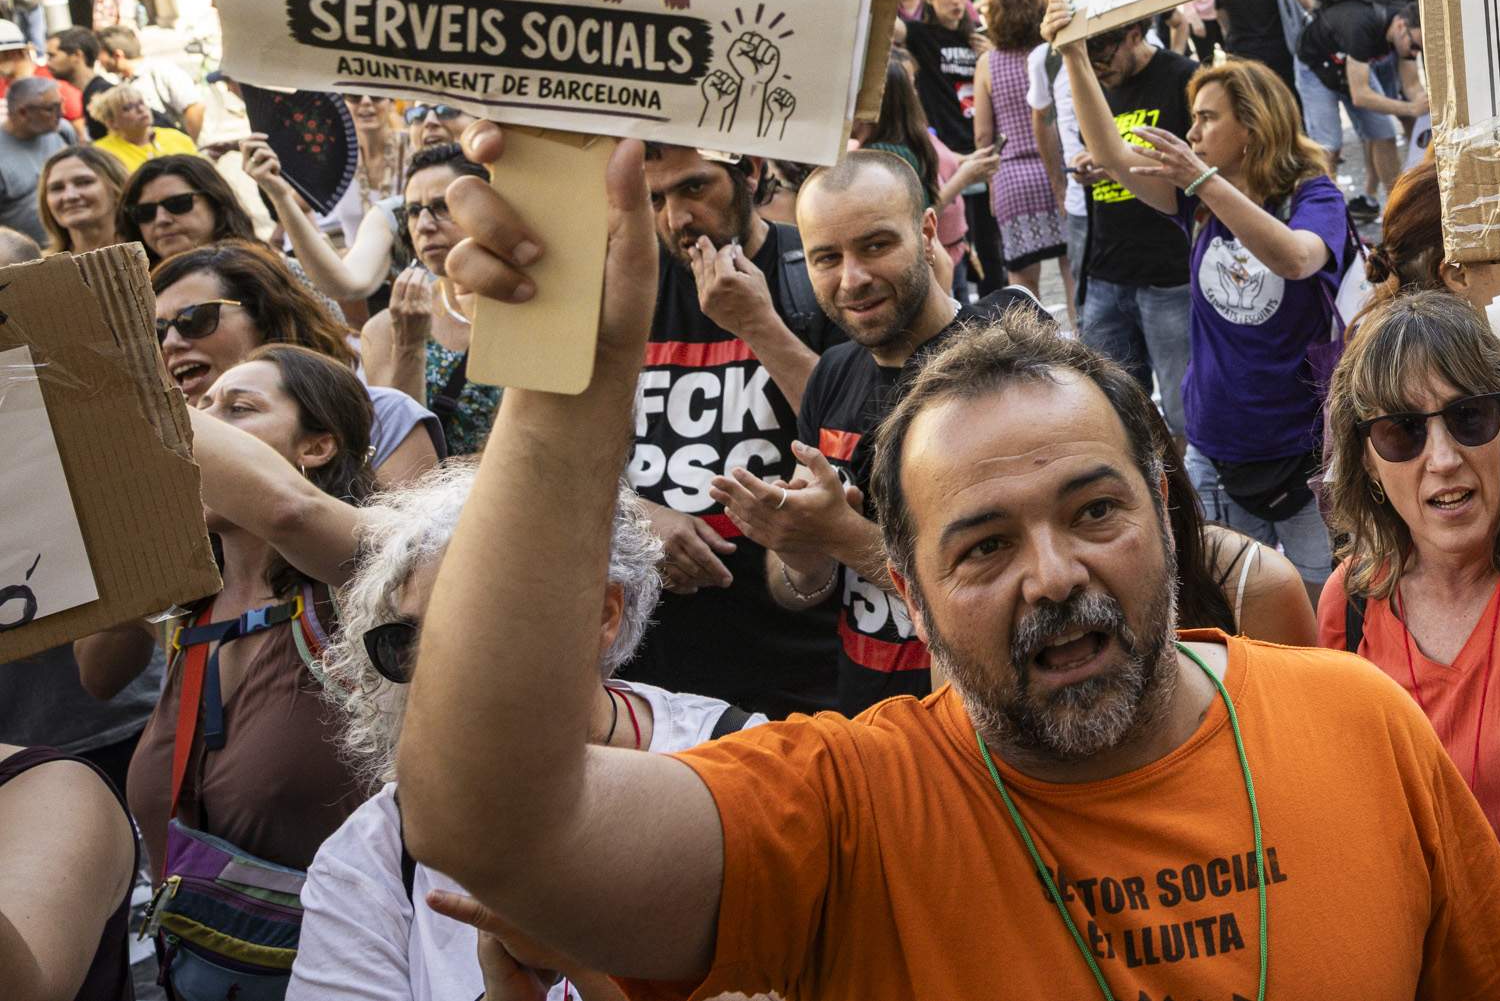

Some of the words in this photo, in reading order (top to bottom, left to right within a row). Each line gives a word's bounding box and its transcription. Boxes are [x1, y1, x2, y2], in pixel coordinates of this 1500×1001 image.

[521, 10, 695, 74] SOCIALS
[336, 54, 495, 95] AJUNTAMENT
[502, 76, 530, 97] DE
[537, 78, 663, 111] BARCELONA
[635, 366, 780, 438] FCK
[1156, 847, 1288, 908] SOCIAL
[1123, 912, 1245, 968] LLUITA
